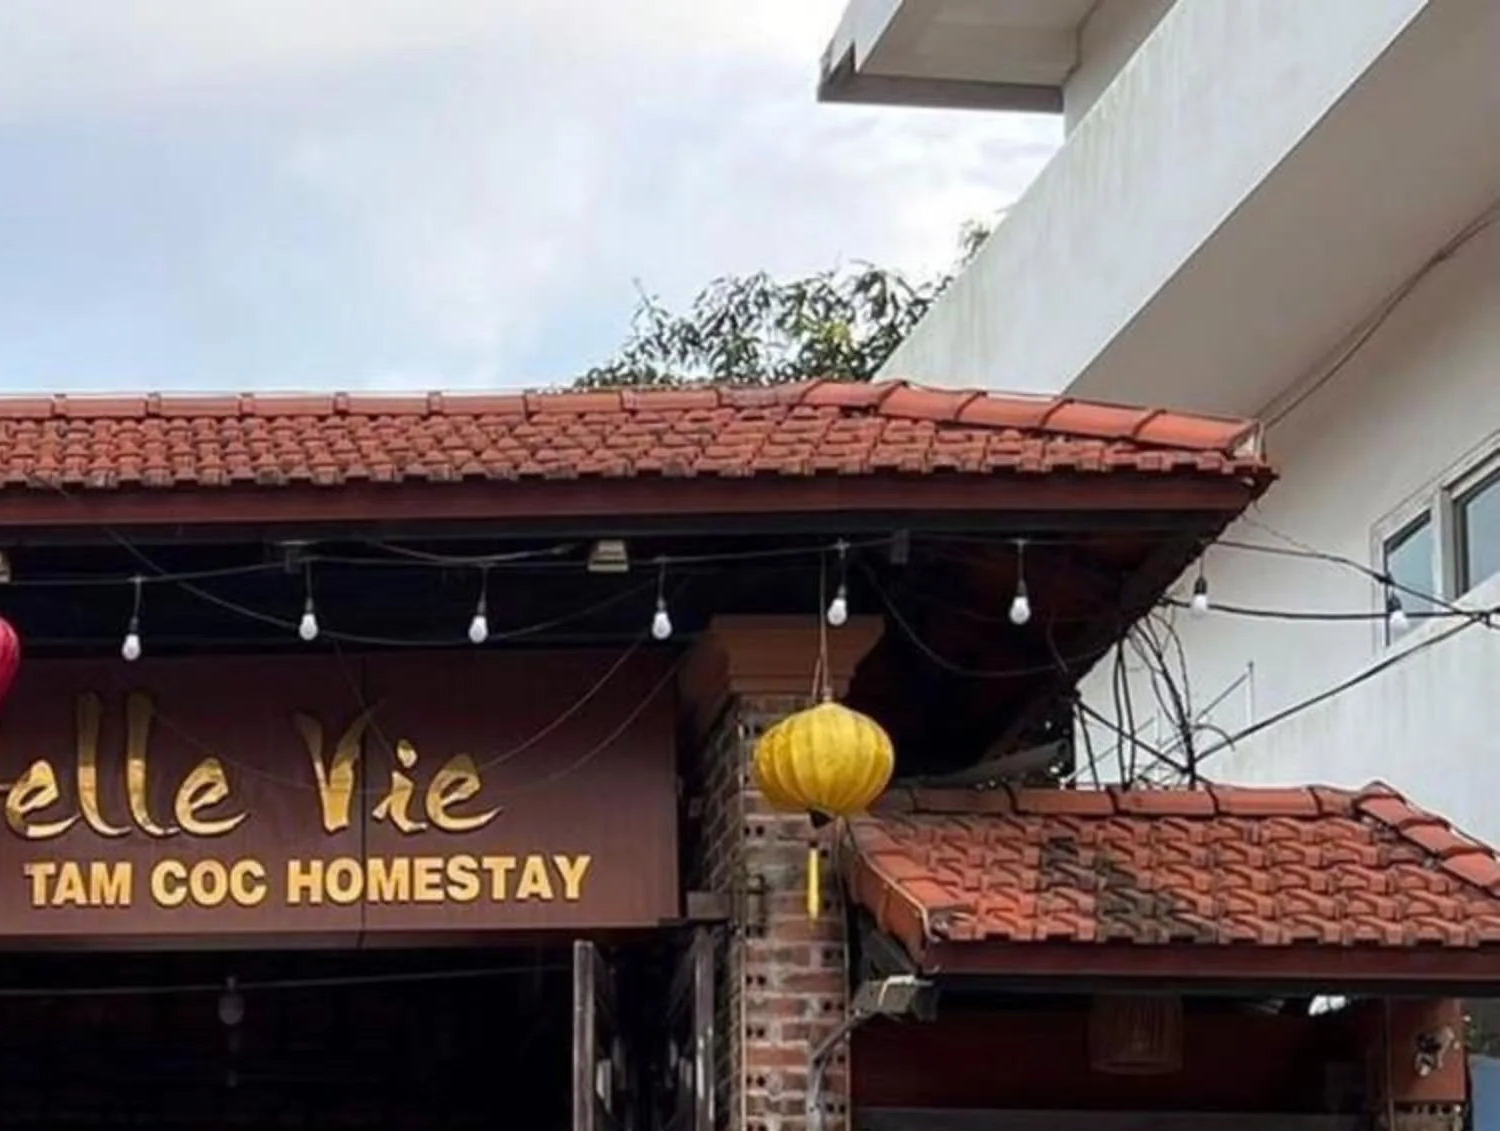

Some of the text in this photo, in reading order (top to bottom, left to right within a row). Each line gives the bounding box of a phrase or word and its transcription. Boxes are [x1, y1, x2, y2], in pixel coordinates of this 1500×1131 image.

[293, 698, 502, 835] Vie
[24, 853, 592, 906] TAM COC HOMESTAY
